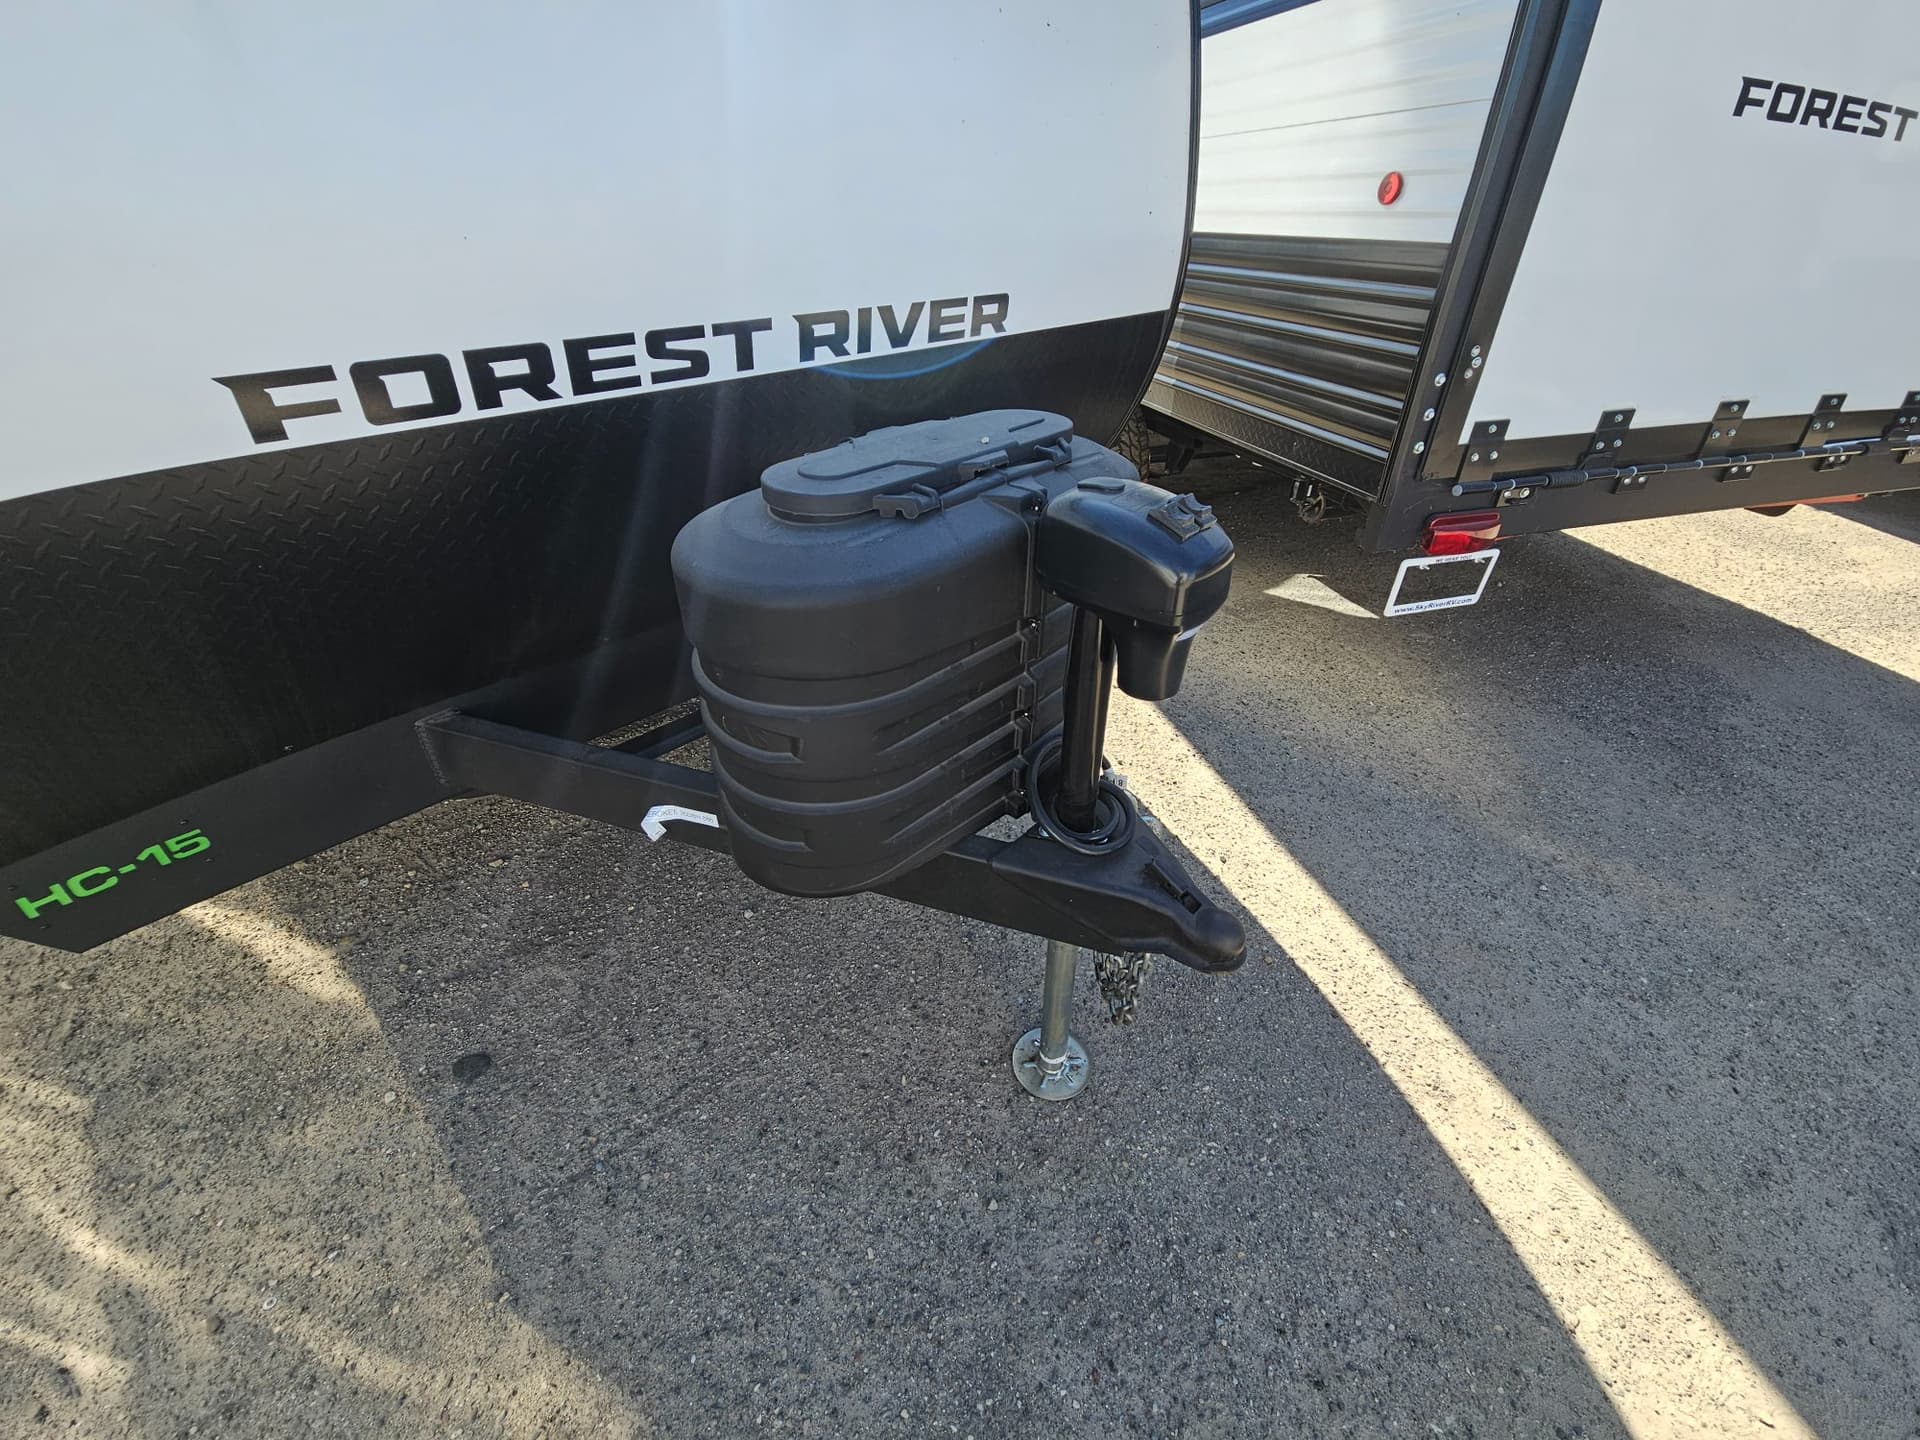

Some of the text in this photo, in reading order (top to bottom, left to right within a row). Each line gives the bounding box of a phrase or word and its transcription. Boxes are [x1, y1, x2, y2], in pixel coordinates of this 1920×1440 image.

[1732, 76, 1919, 142] FOREST
[211, 292, 1010, 444] FOREST RIVER
[15, 828, 212, 919] HC-15
